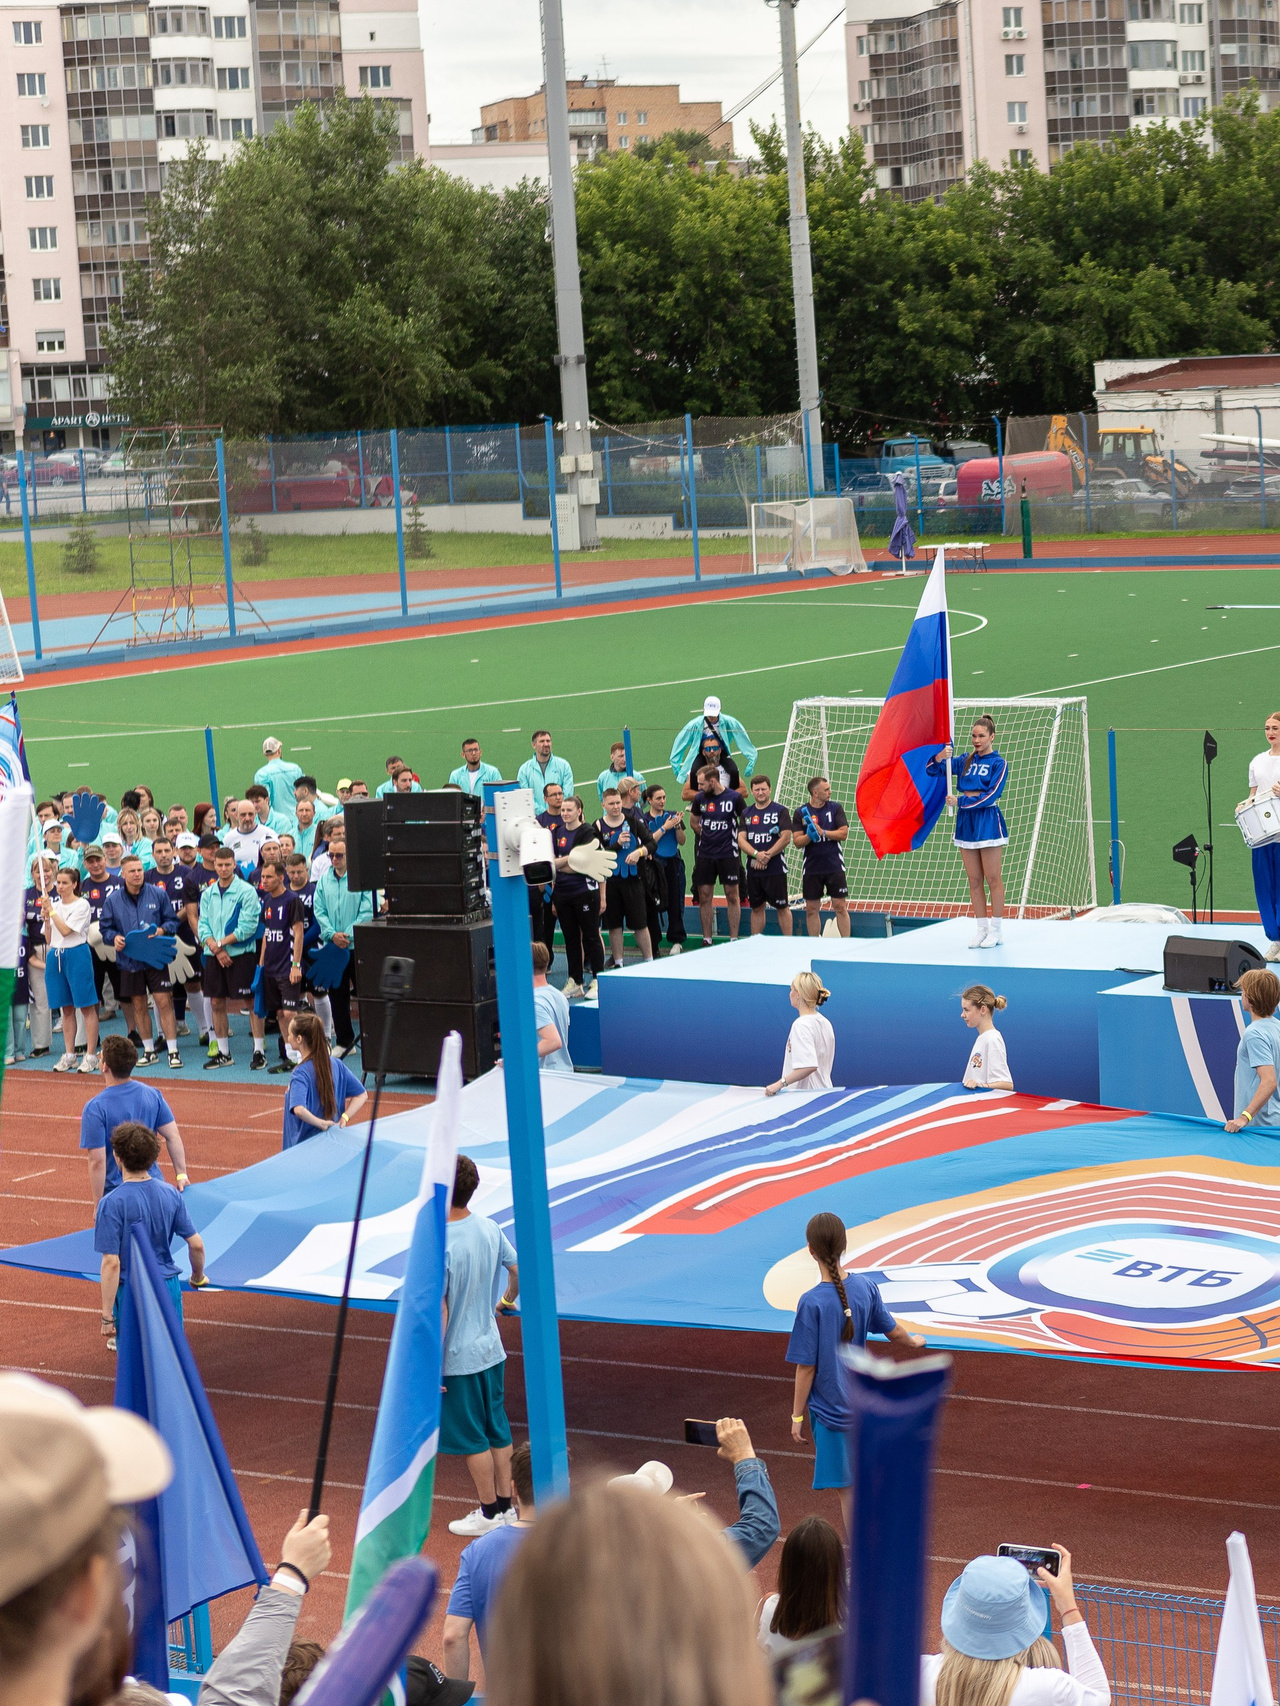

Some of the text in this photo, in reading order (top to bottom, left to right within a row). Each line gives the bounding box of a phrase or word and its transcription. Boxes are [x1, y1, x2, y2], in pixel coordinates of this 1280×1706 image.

[51, 415, 82, 426] APART
[1069, 448, 1084, 470] JCB
[719, 801, 733, 813] 10
[763, 813, 779, 825] 55
[825, 811, 832, 823] 1
[710, 820, 728, 831] ВТБ
[174, 876, 184, 889] 3
[277, 906, 283, 920] 1
[266, 930, 284, 942] ВТБ
[1112, 1259, 1243, 1289] ВТБ
